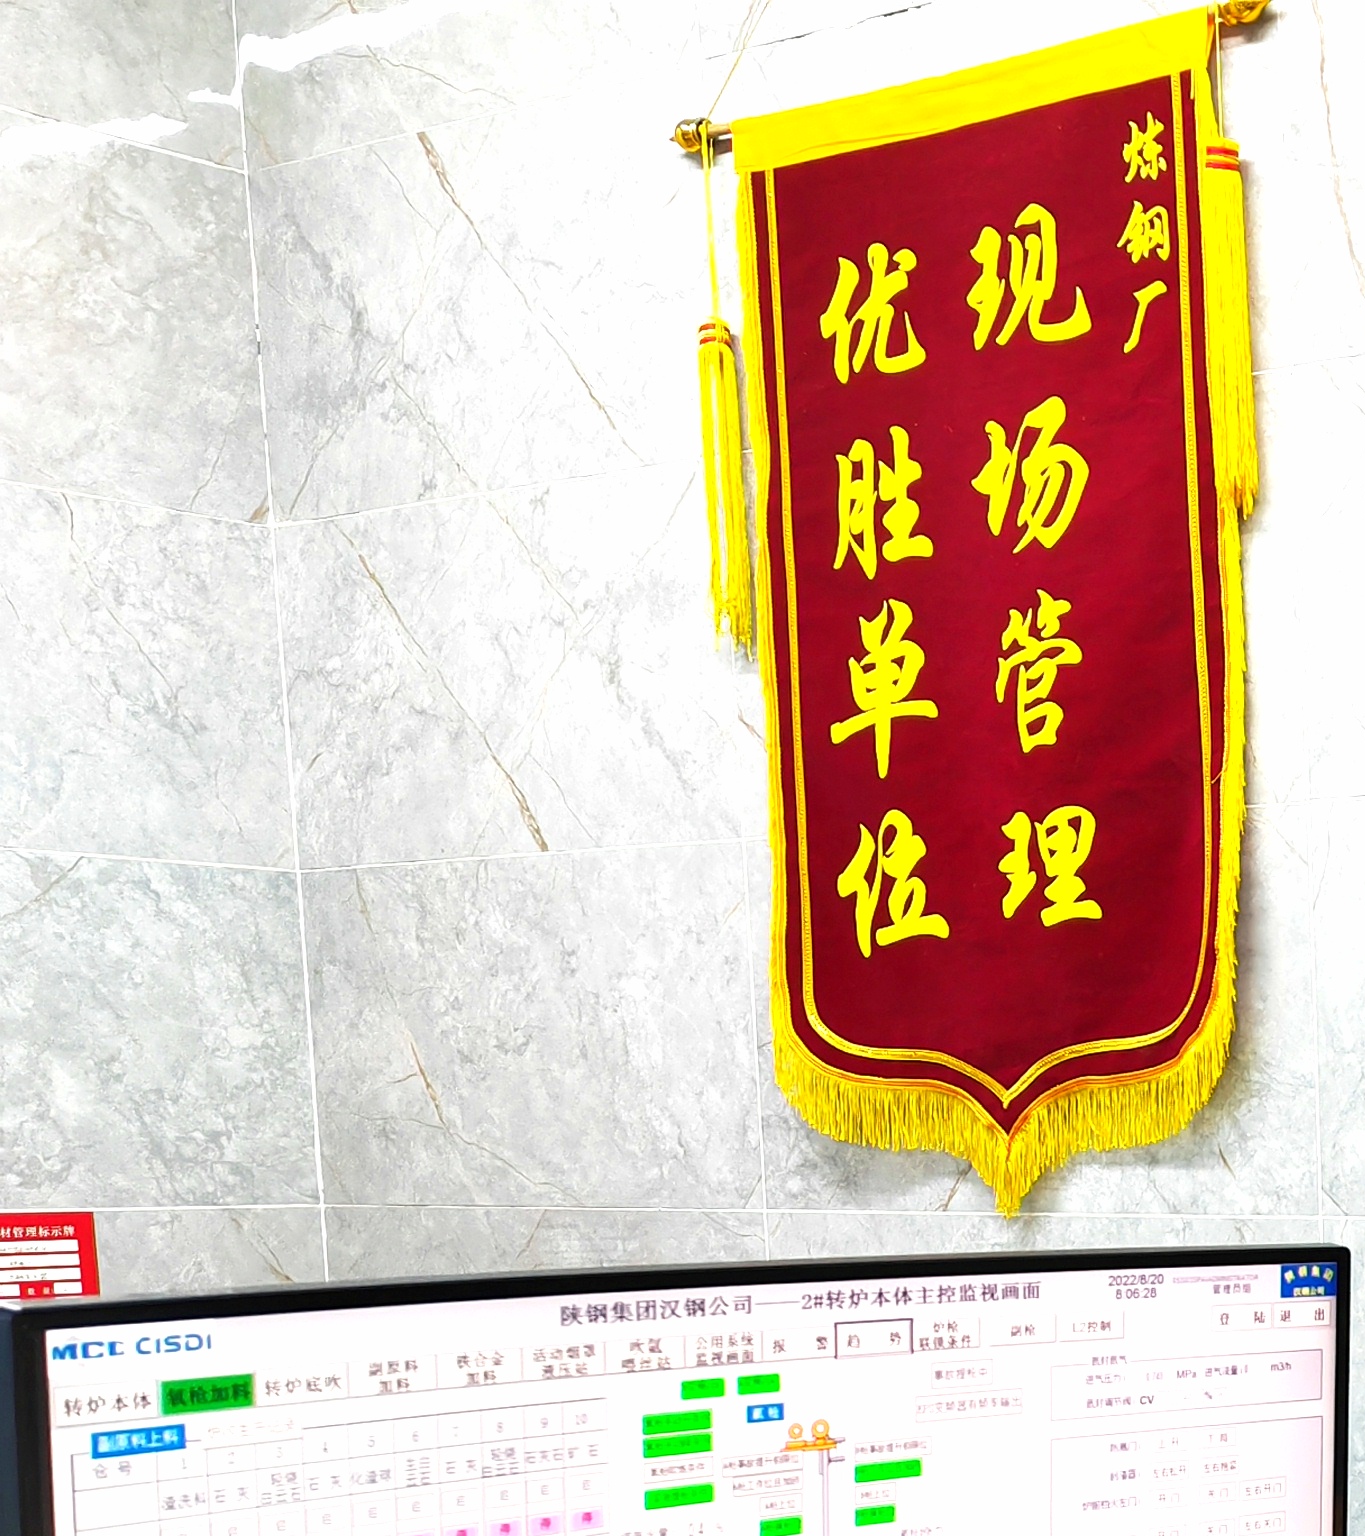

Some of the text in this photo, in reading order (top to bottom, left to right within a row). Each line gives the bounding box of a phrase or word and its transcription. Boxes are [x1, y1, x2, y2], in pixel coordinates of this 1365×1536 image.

[1117, 111, 1170, 353] 炼钢厂
[820, 243, 949, 957] 优胜单位
[967, 203, 1102, 927] 现场管理
[136, 1334, 211, 1354] CISDI
[1109, 1274, 1164, 1287] 2022/8/20
